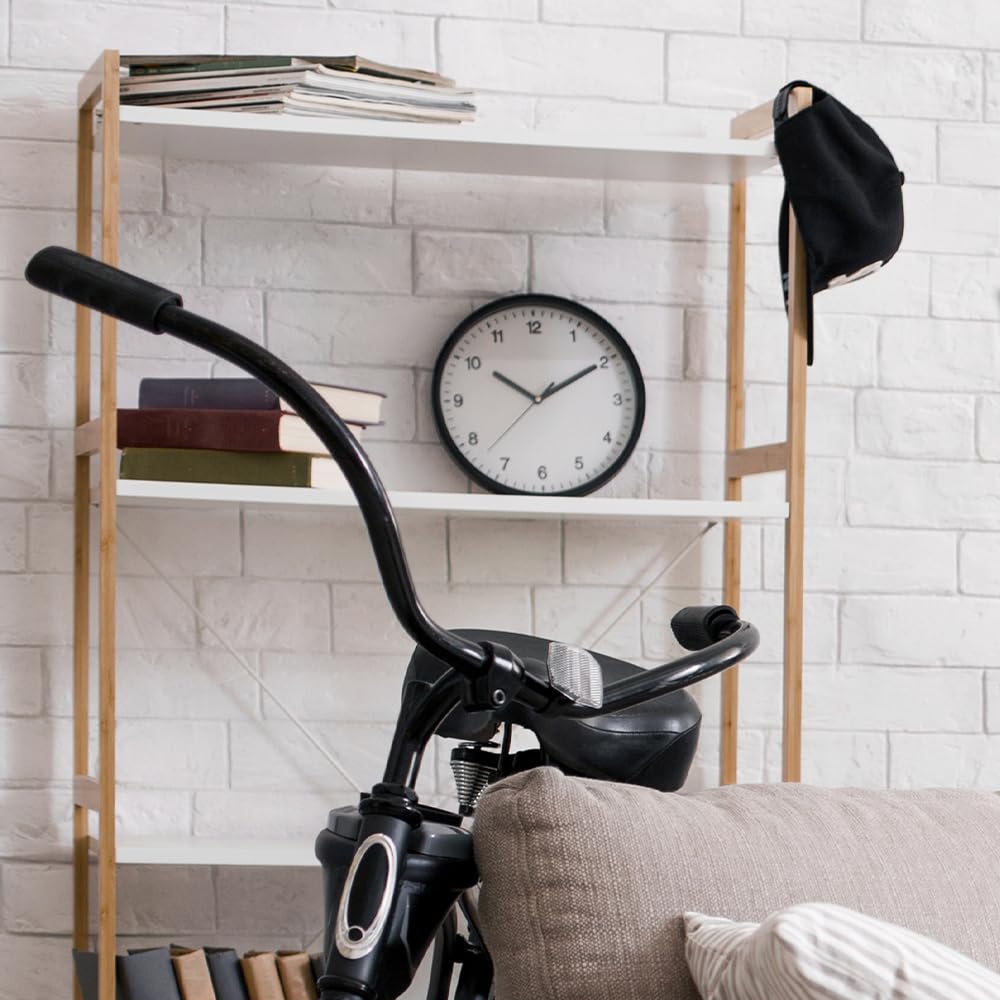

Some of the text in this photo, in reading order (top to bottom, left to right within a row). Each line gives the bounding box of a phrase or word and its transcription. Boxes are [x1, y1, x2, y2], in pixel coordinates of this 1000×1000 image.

[526, 321, 542, 335] 12
[491, 329, 503, 343] 11
[569, 330, 576, 342] 1
[465, 356, 482, 370] 10
[599, 356, 609, 369] 2
[453, 394, 464, 407] 9
[613, 393, 623, 406] 3
[468, 432, 479, 446] 8
[602, 431, 612, 444] 4
[500, 457, 510, 471] 7
[574, 456, 584, 470] 5
[537, 466, 548, 479] 6
